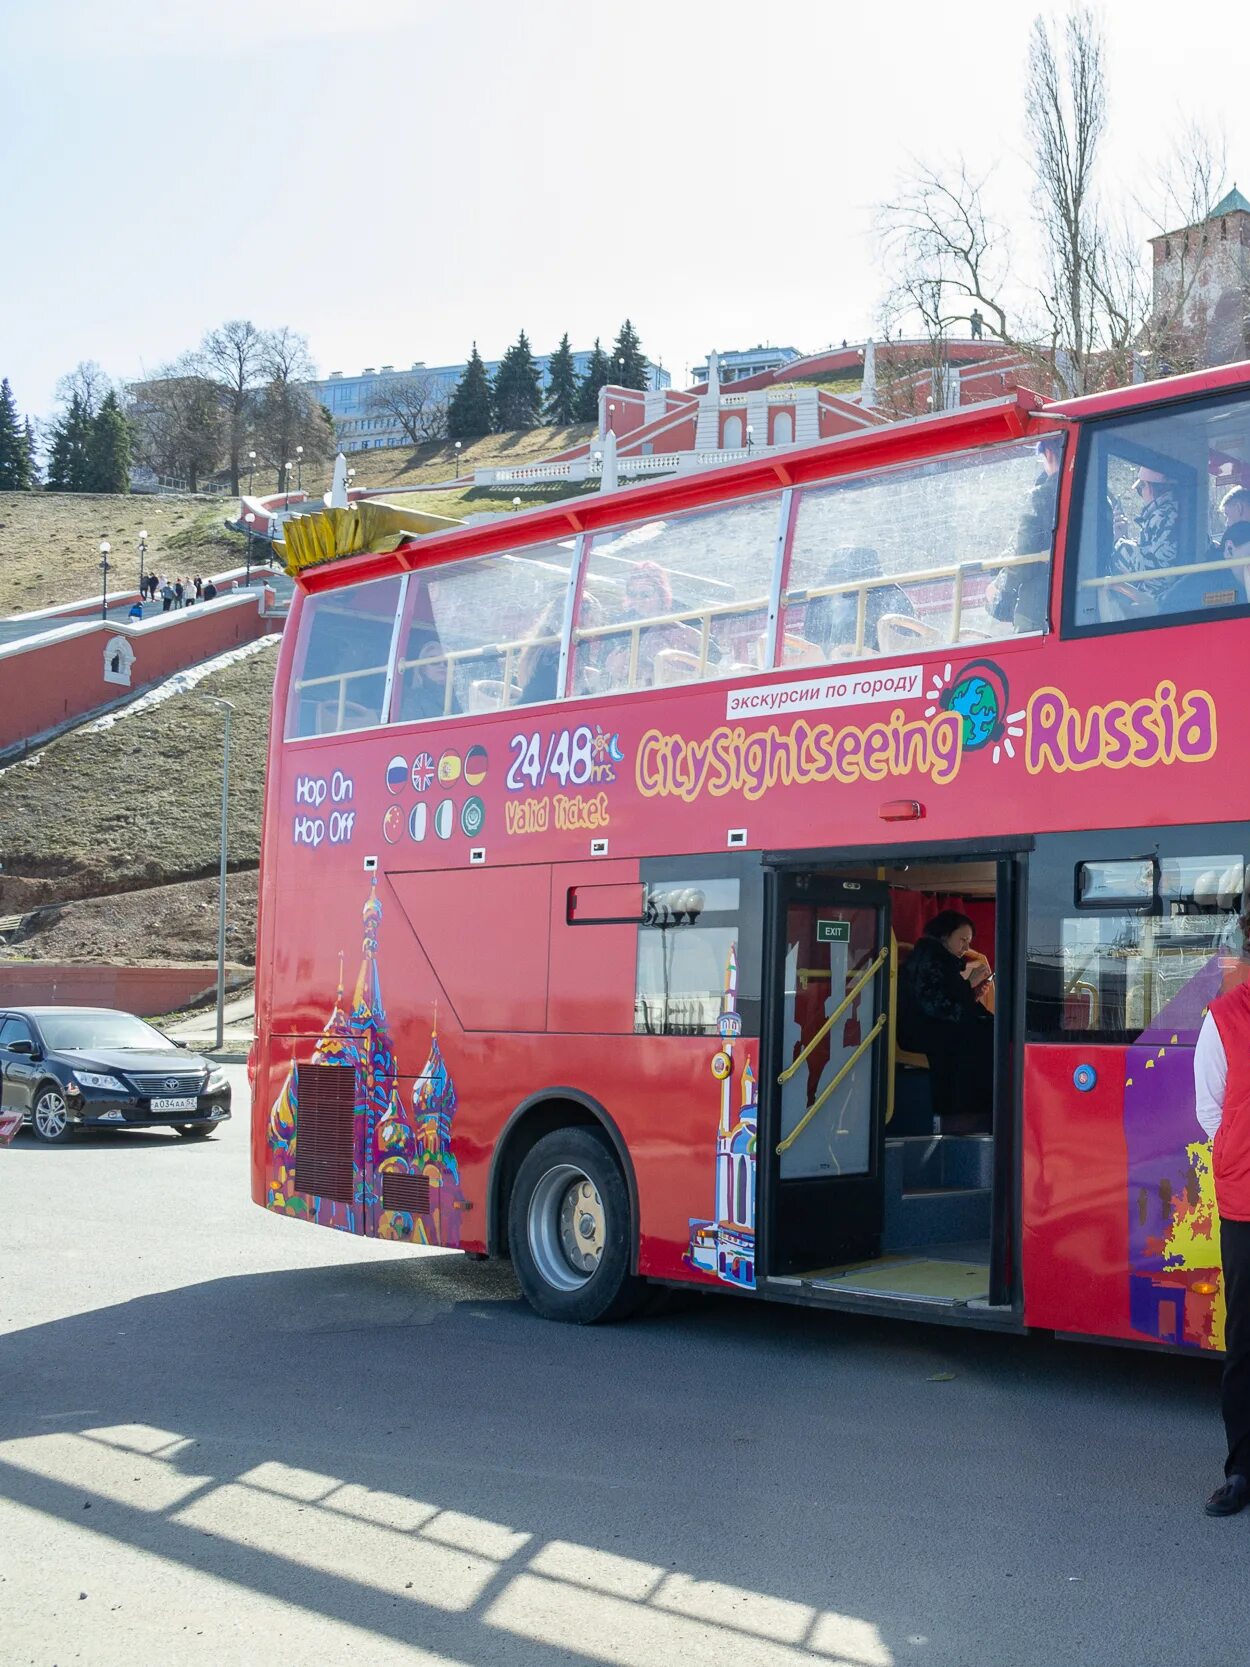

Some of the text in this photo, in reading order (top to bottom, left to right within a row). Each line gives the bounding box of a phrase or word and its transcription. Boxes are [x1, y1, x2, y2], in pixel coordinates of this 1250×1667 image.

[730, 674, 918, 710] экскурсии по городу
[506, 727, 592, 789] 24/48
[635, 679, 1218, 803] CitySightseeing Russia
[296, 771, 353, 807] Hop On
[294, 811, 356, 847] Hop Off
[505, 791, 610, 835] Valid Ticket
[825, 927, 843, 936] EXIT
